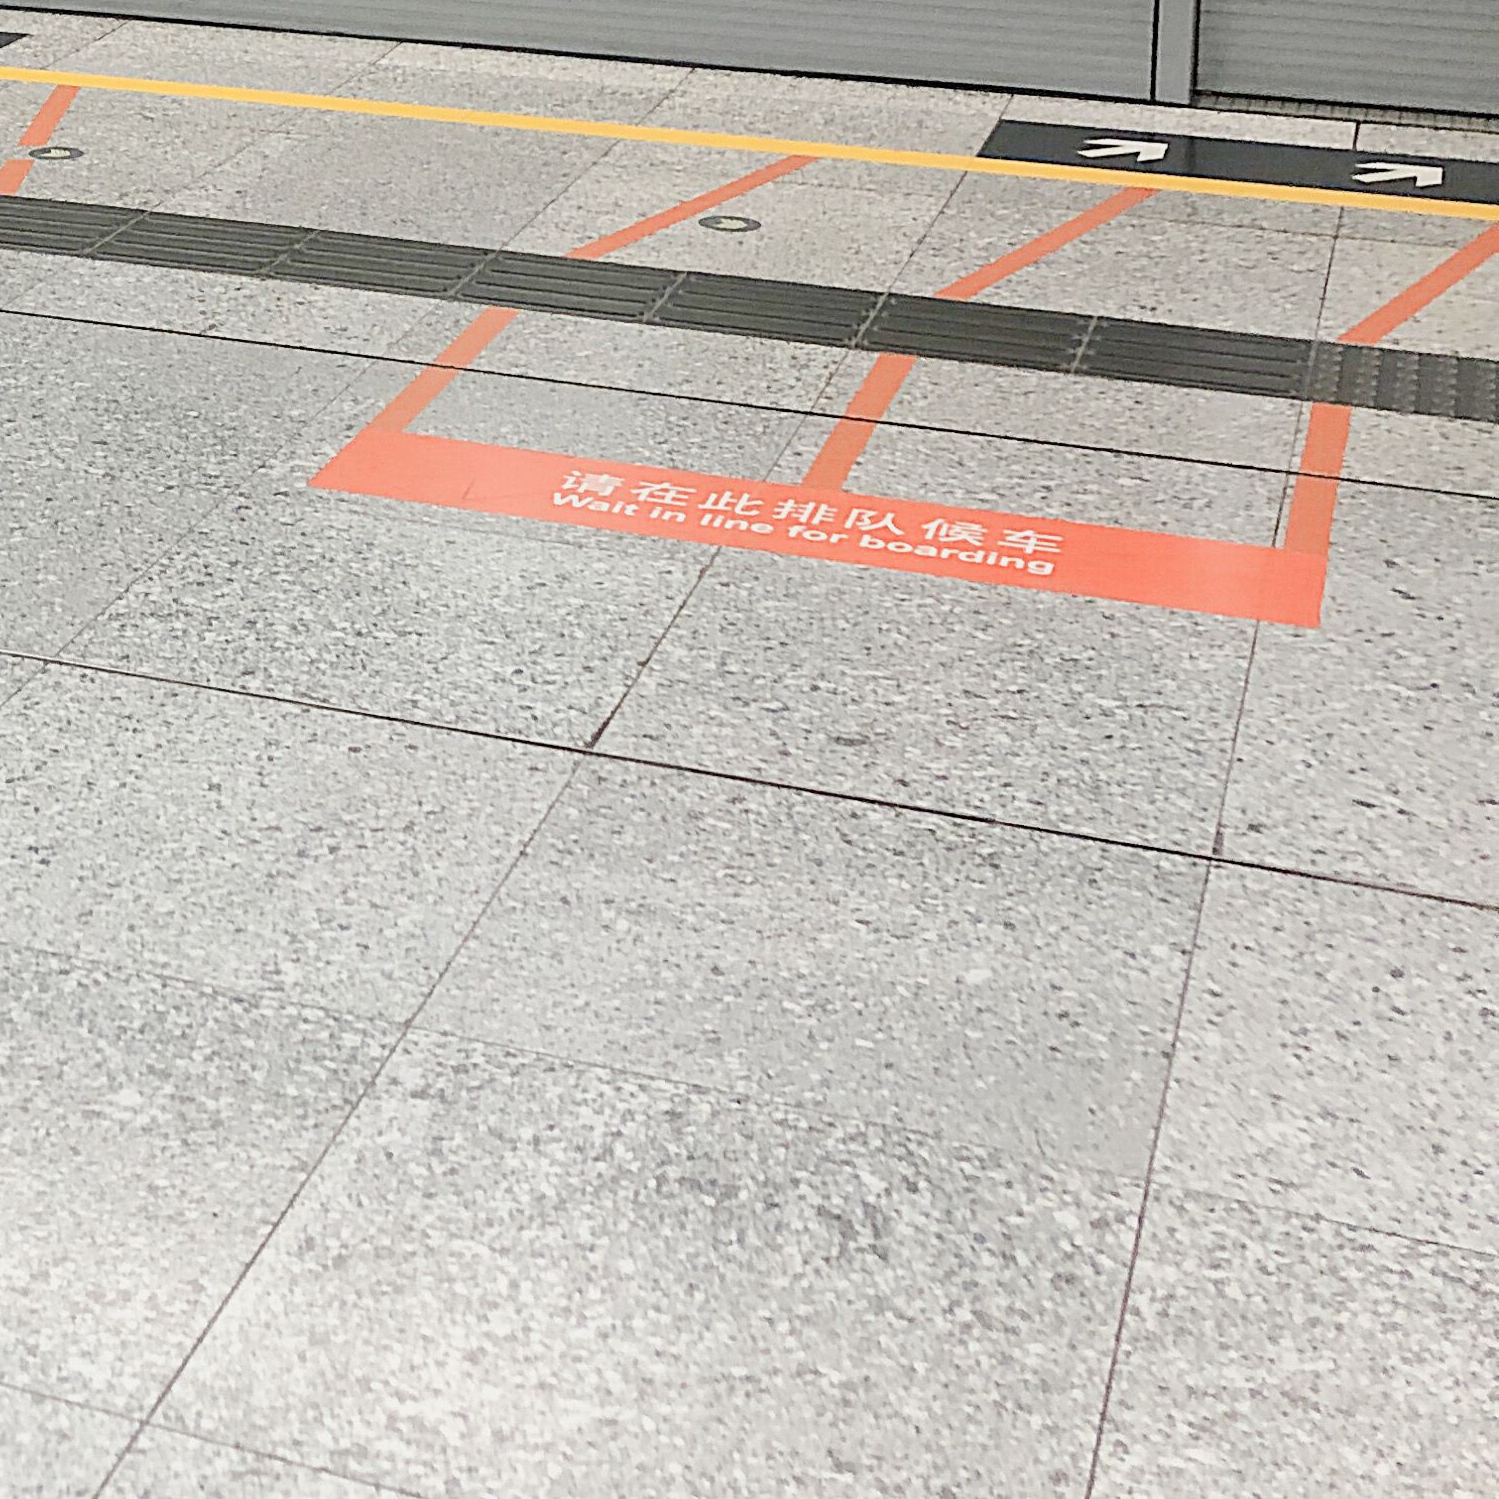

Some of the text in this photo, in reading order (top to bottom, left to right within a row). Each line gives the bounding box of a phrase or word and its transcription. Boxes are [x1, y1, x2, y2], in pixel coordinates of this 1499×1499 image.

[552, 492, 1054, 576] Wait in line for boarding
[560, 469, 1063, 557] 请在此排队候车
